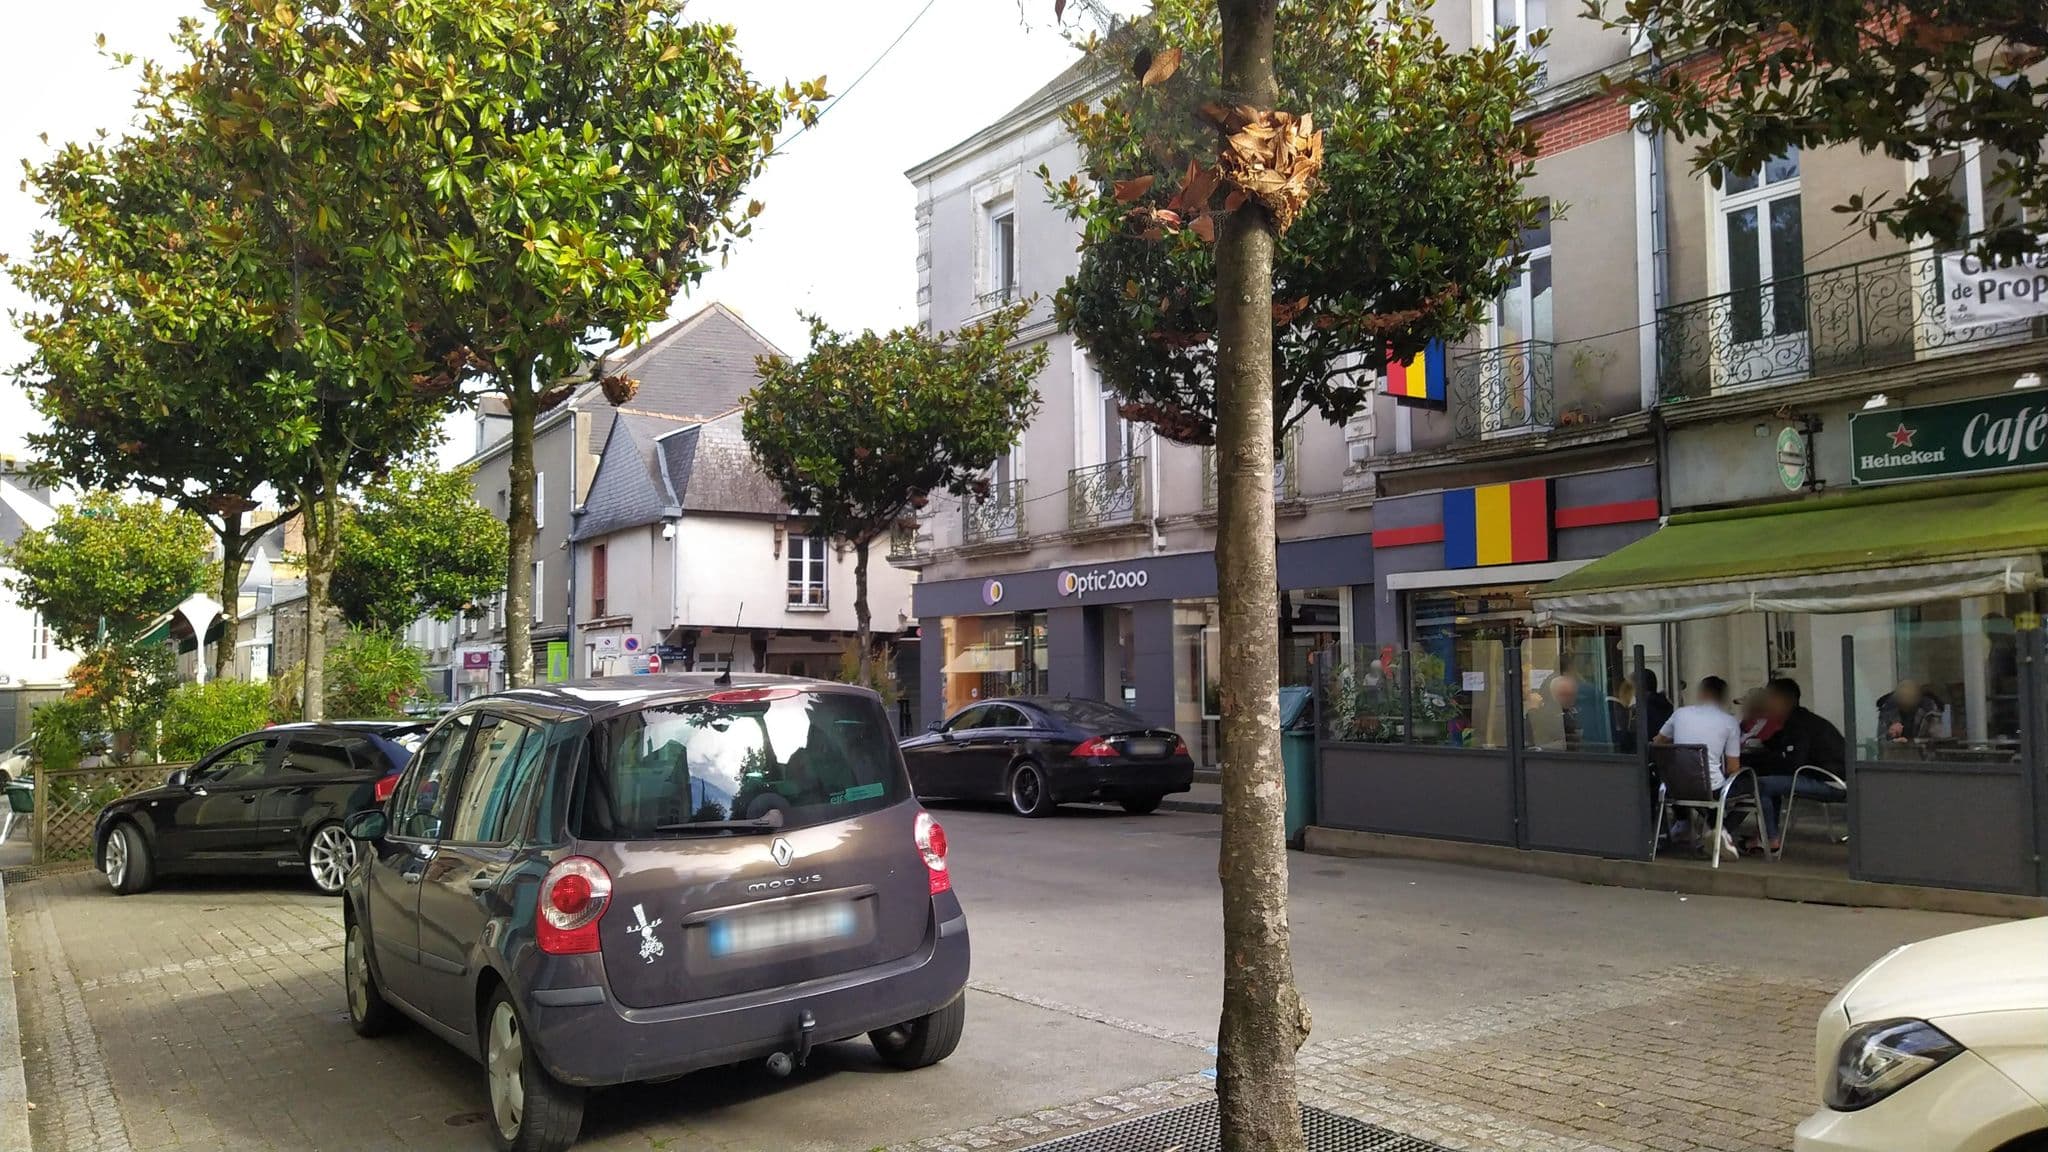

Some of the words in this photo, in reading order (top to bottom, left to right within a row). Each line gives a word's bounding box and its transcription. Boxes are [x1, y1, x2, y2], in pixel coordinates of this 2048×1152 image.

[1951, 283, 1973, 300] de
[1962, 407, 2048, 462] Café
[1861, 449, 1945, 470] Heineken
